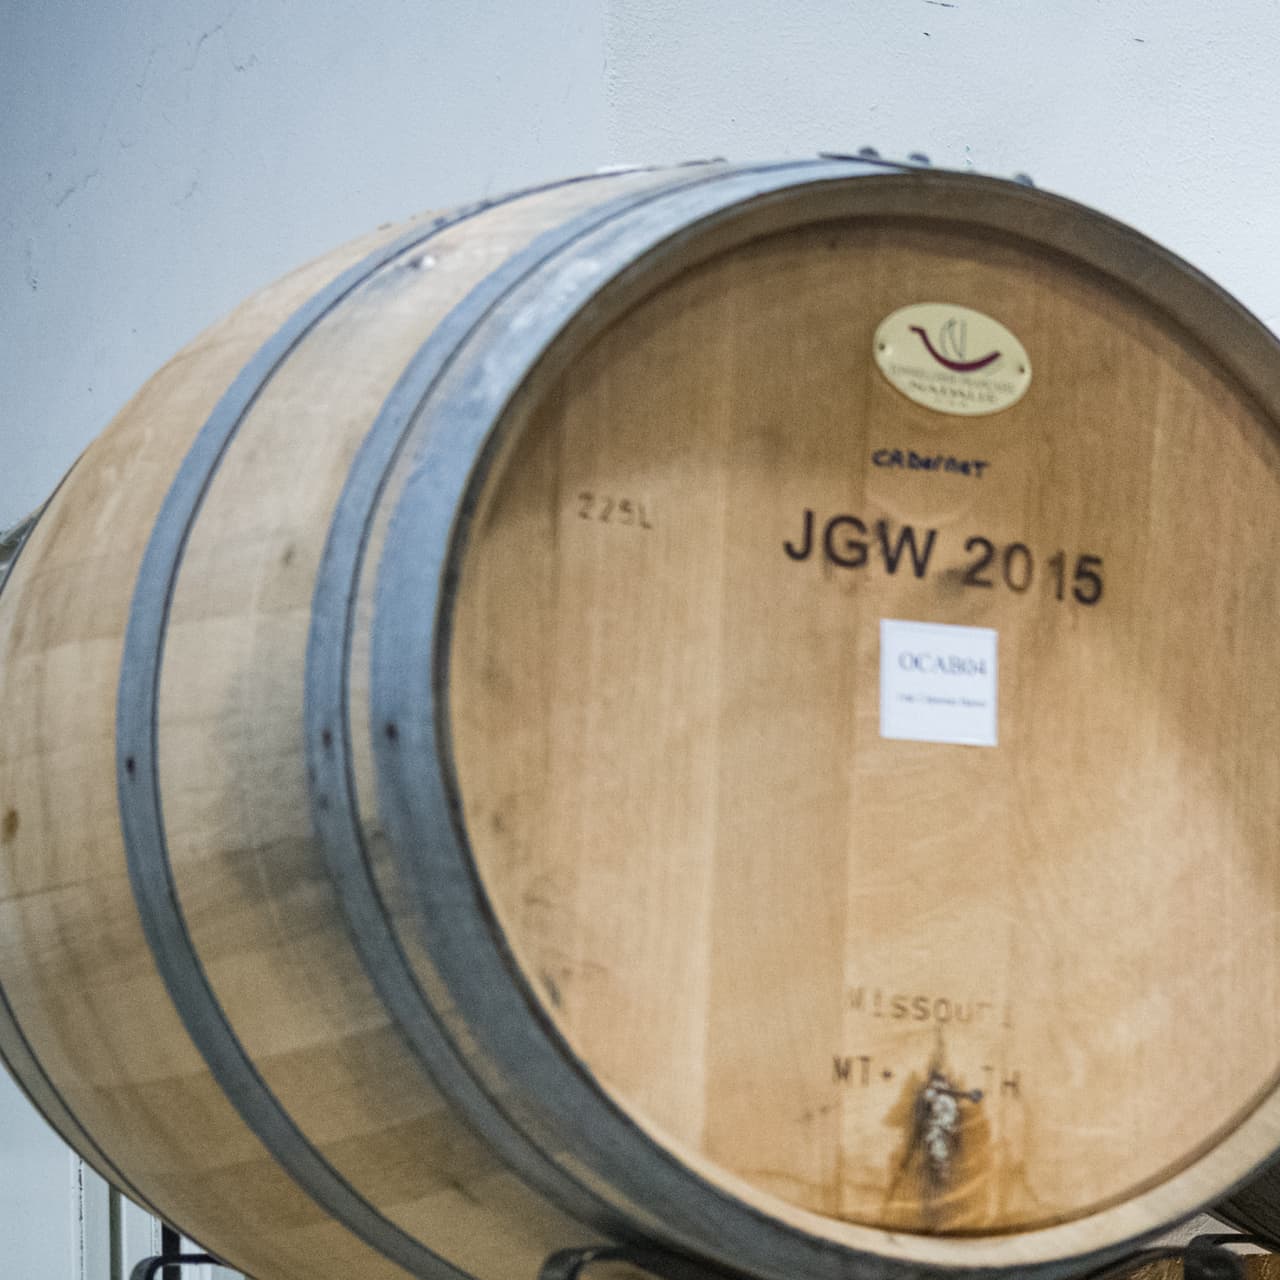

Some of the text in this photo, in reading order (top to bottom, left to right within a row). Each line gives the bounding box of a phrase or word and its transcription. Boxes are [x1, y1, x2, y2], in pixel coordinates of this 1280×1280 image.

[578, 491, 653, 529] 225L
[783, 509, 1104, 605] JGW 2015
